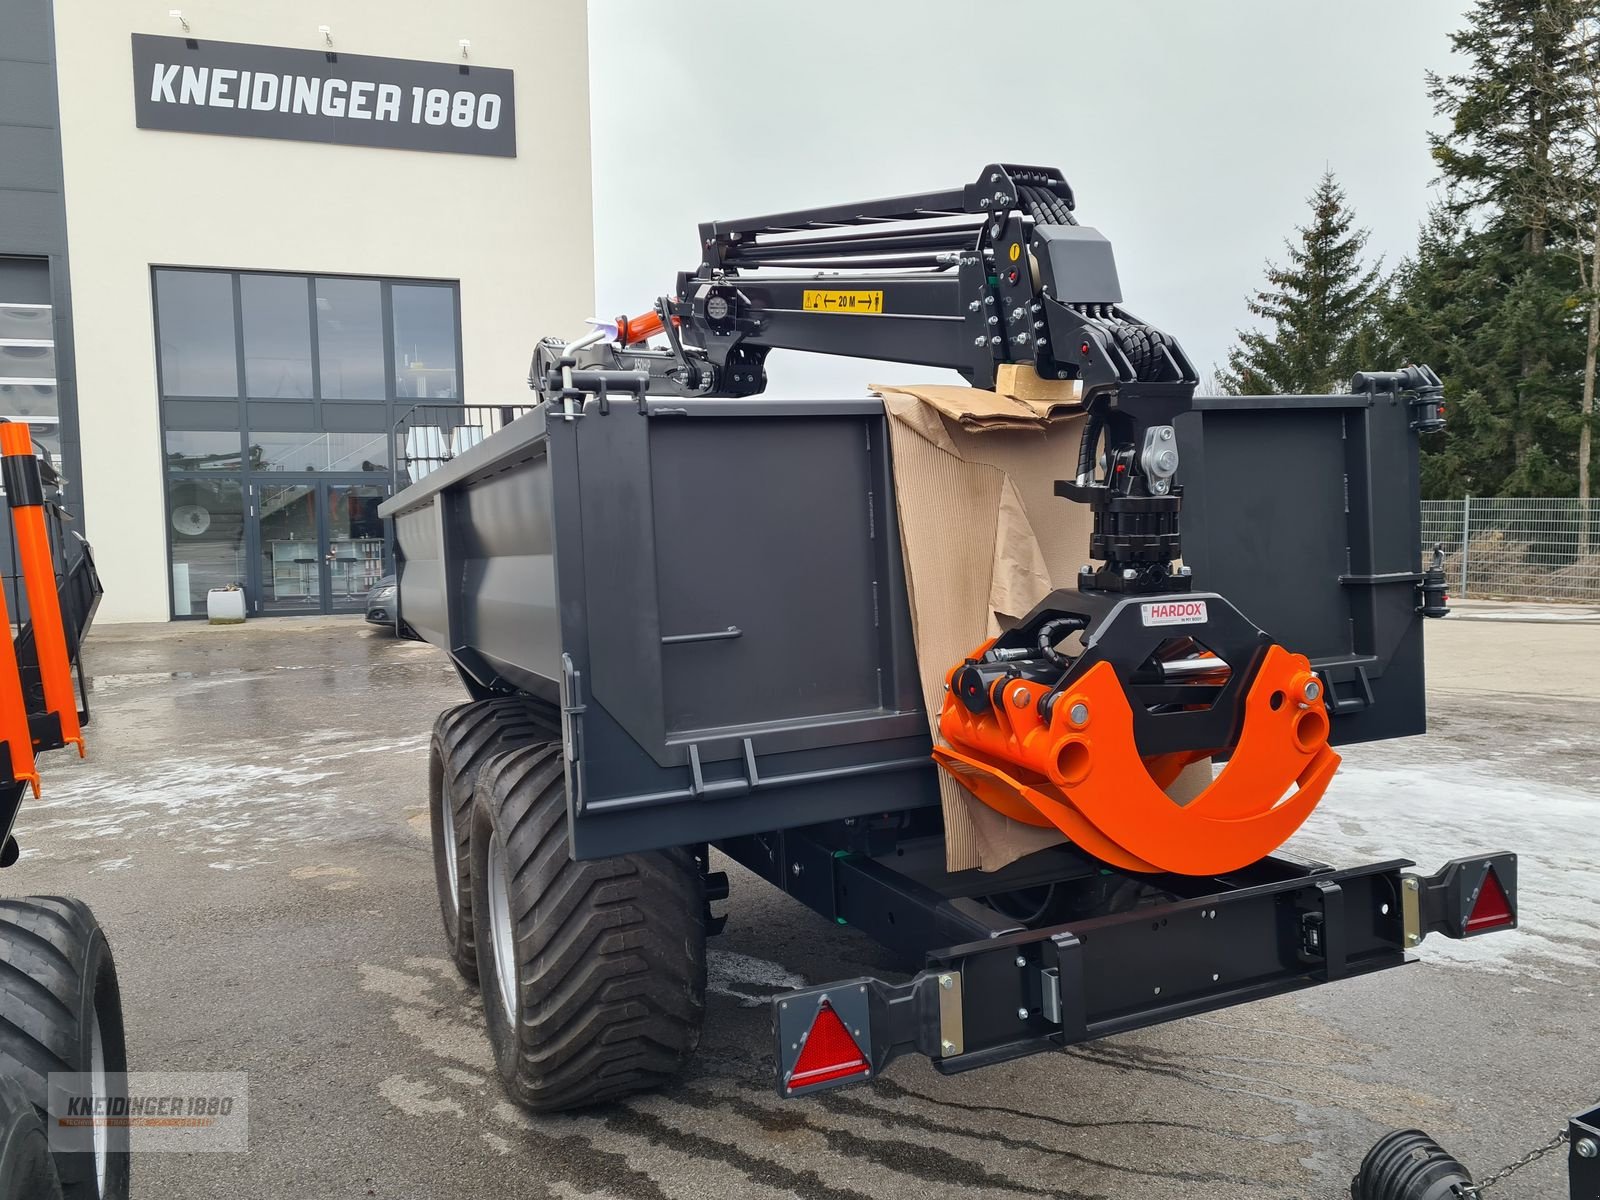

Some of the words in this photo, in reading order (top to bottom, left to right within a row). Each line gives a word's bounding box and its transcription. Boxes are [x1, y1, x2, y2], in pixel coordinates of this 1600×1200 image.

[151, 63, 402, 122] KNEIDINGER
[411, 86, 502, 131] 1880
[838, 295, 847, 307] 20
[849, 295, 856, 307] M
[1151, 603, 1202, 618] HARDOX
